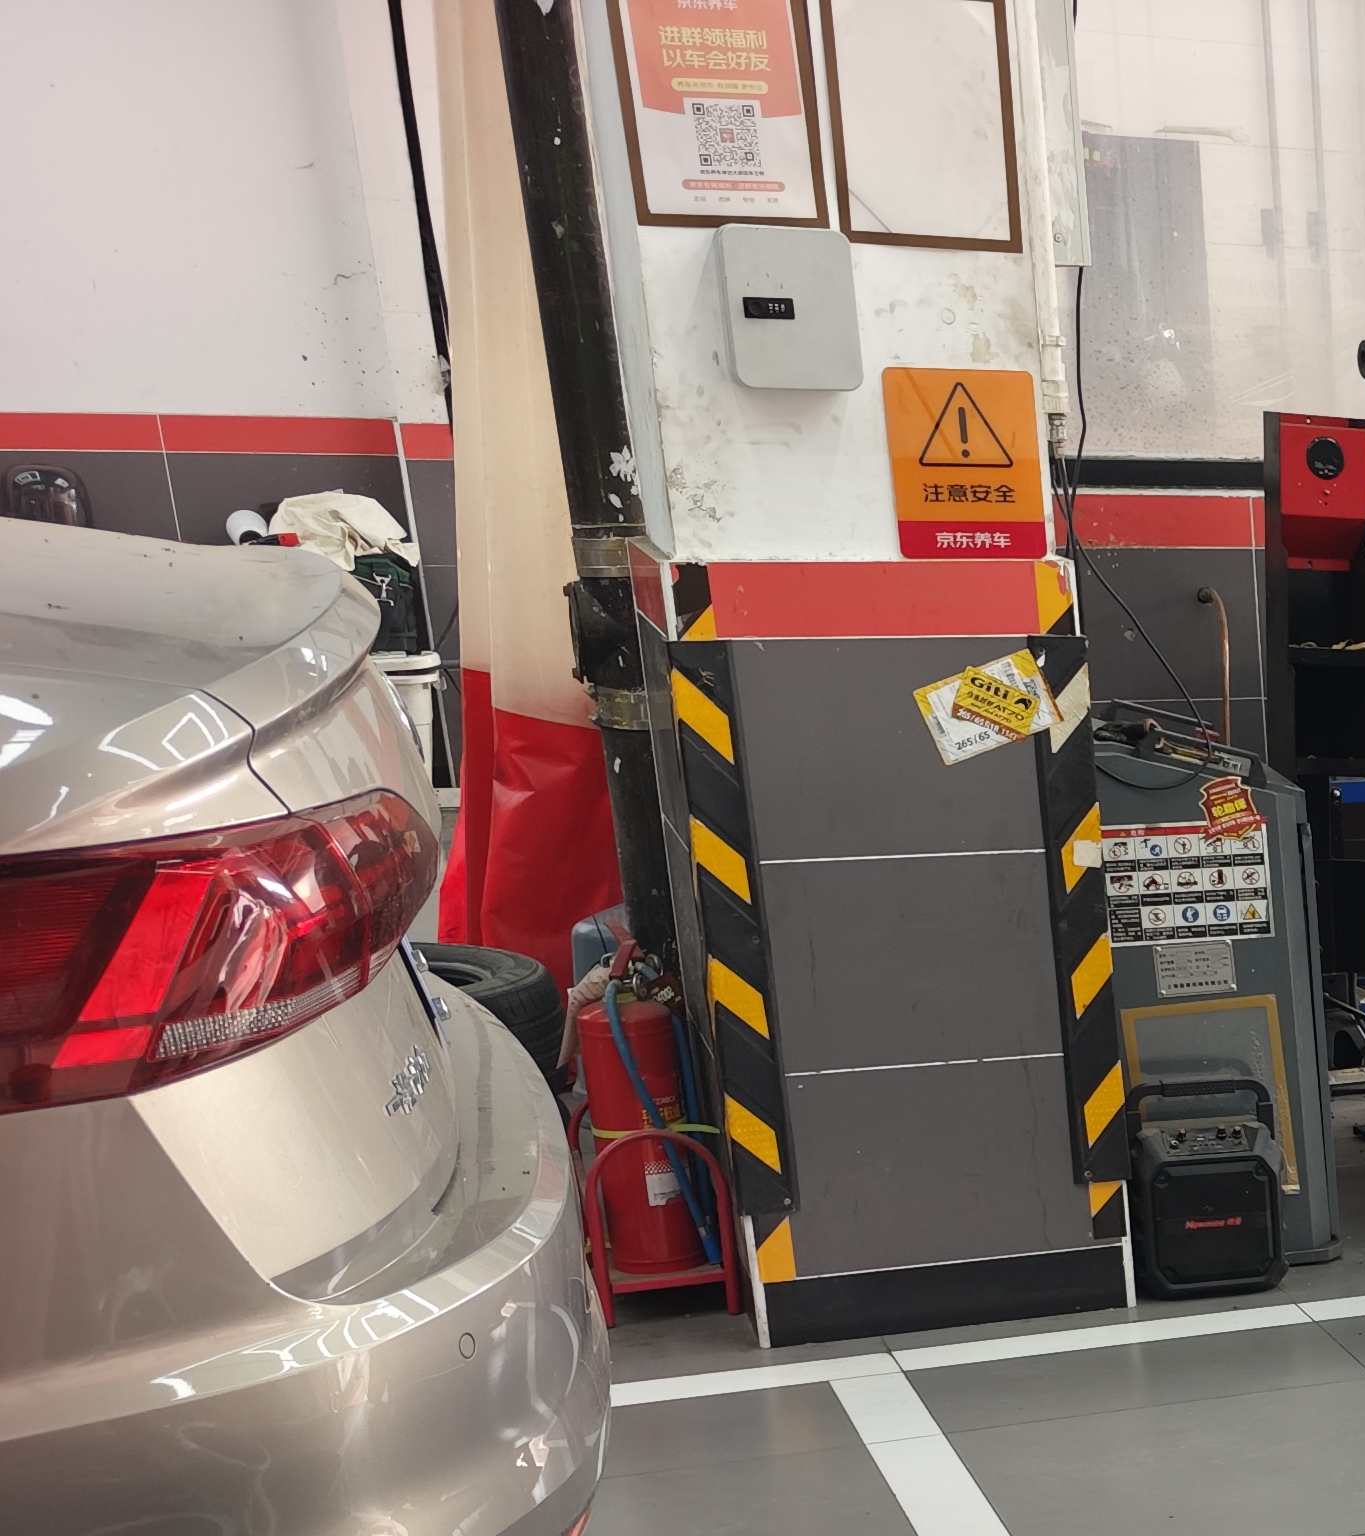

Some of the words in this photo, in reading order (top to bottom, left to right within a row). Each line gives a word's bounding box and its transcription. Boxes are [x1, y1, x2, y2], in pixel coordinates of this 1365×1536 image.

[658, 25, 767, 50] 进群领福利
[662, 48, 772, 72] 以车会好友
[923, 482, 1016, 503] 注意安全
[935, 531, 1012, 549] 京东养车
[970, 676, 1010, 700] Giti
[955, 730, 991, 750] 265/65
